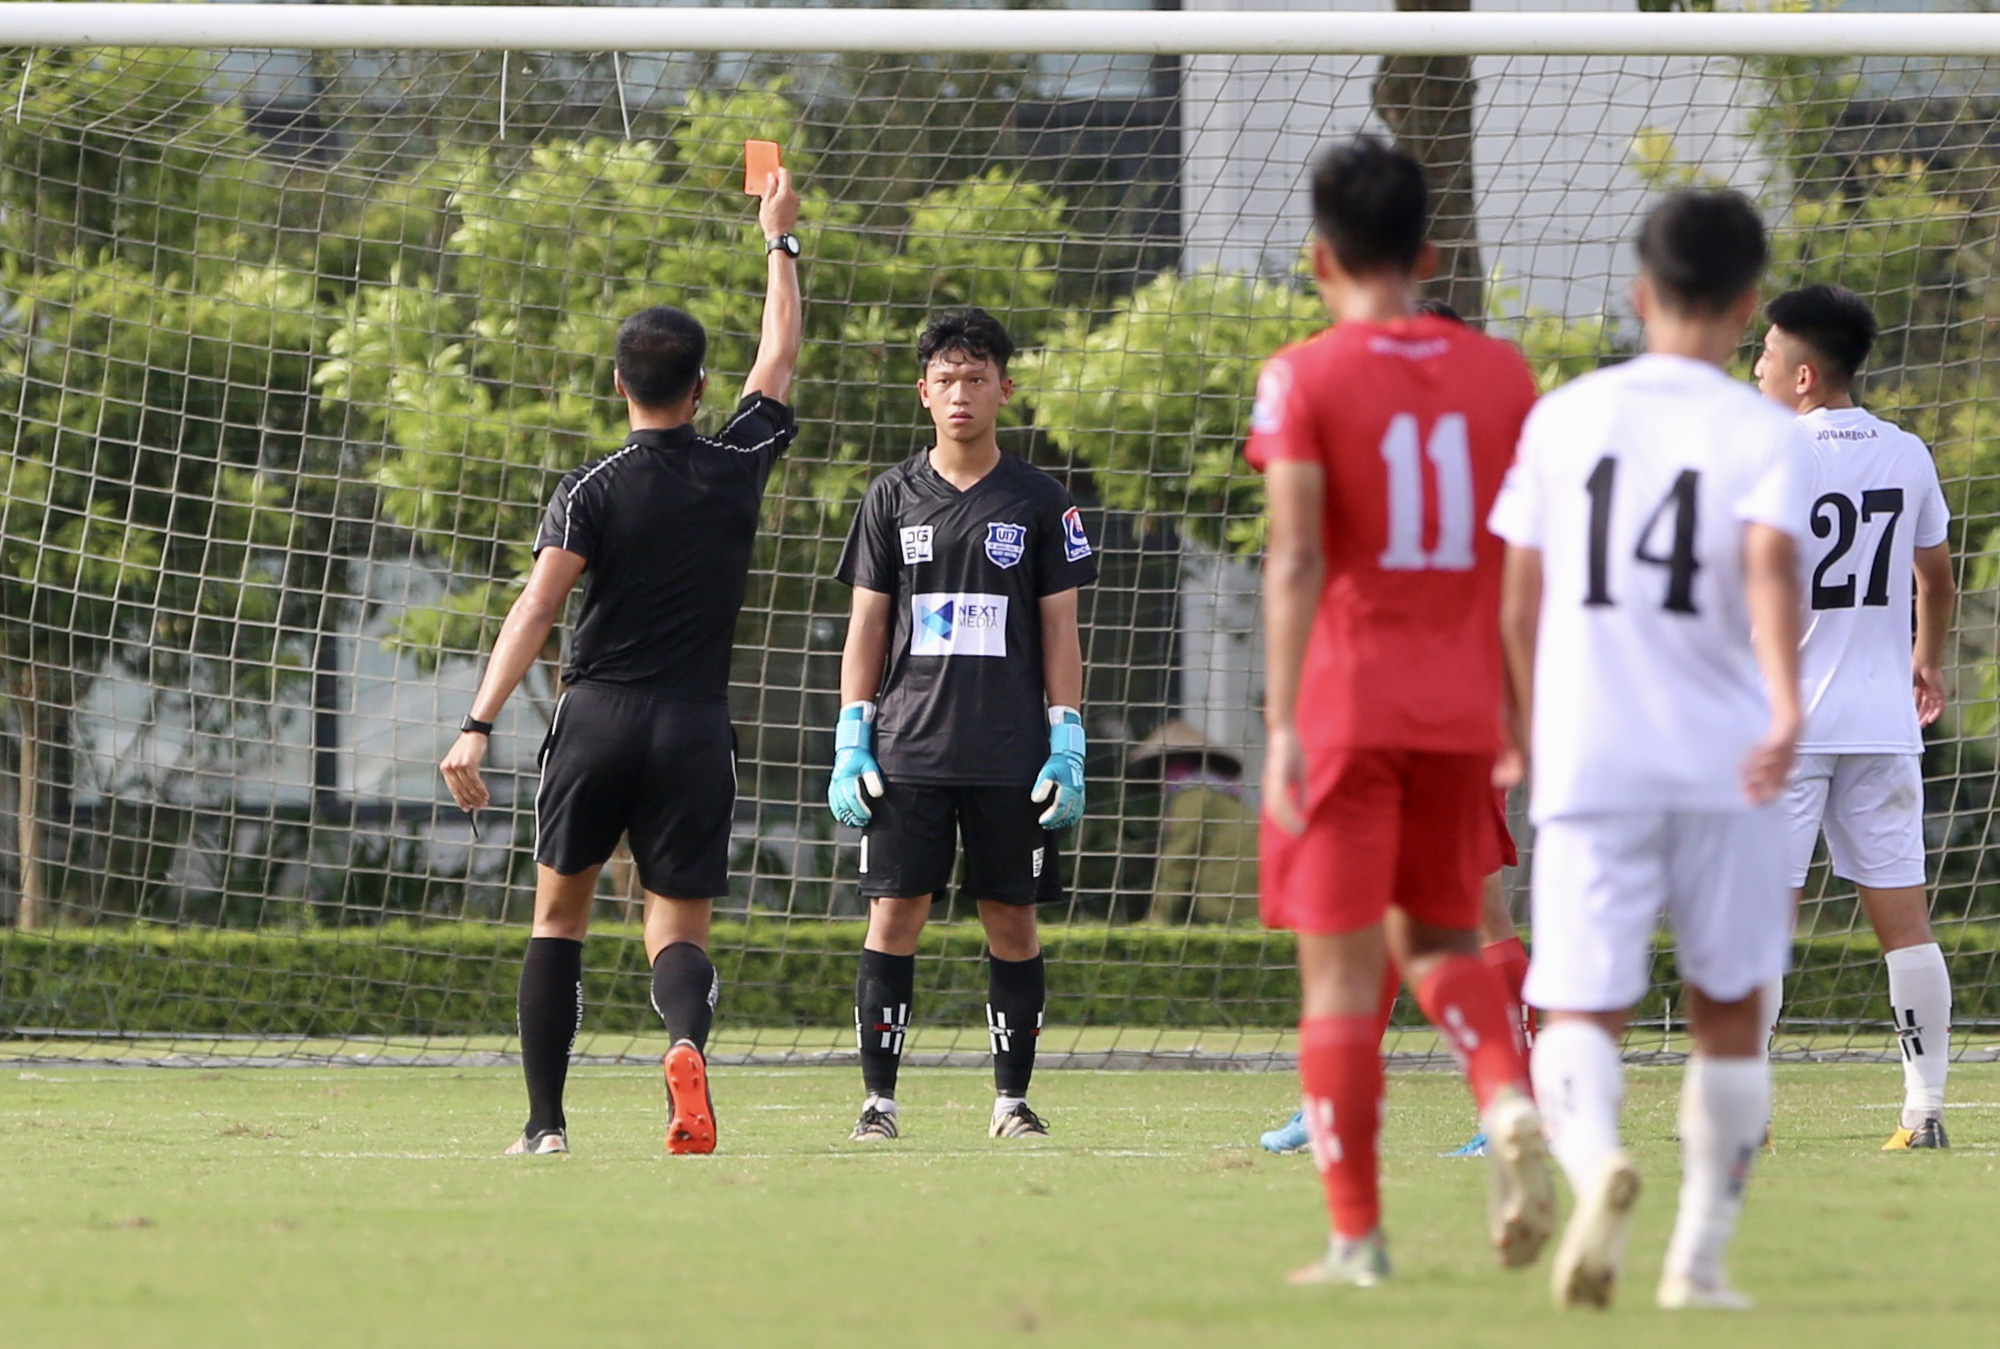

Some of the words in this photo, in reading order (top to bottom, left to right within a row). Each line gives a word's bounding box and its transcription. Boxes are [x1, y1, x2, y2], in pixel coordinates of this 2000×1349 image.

[1379, 413, 1475, 571] 11
[999, 530, 1015, 541] U17
[1582, 456, 1703, 614] 14
[1810, 487, 1904, 611] 27
[958, 616, 998, 628] MEDIA
[959, 605, 998, 617] NEXT
